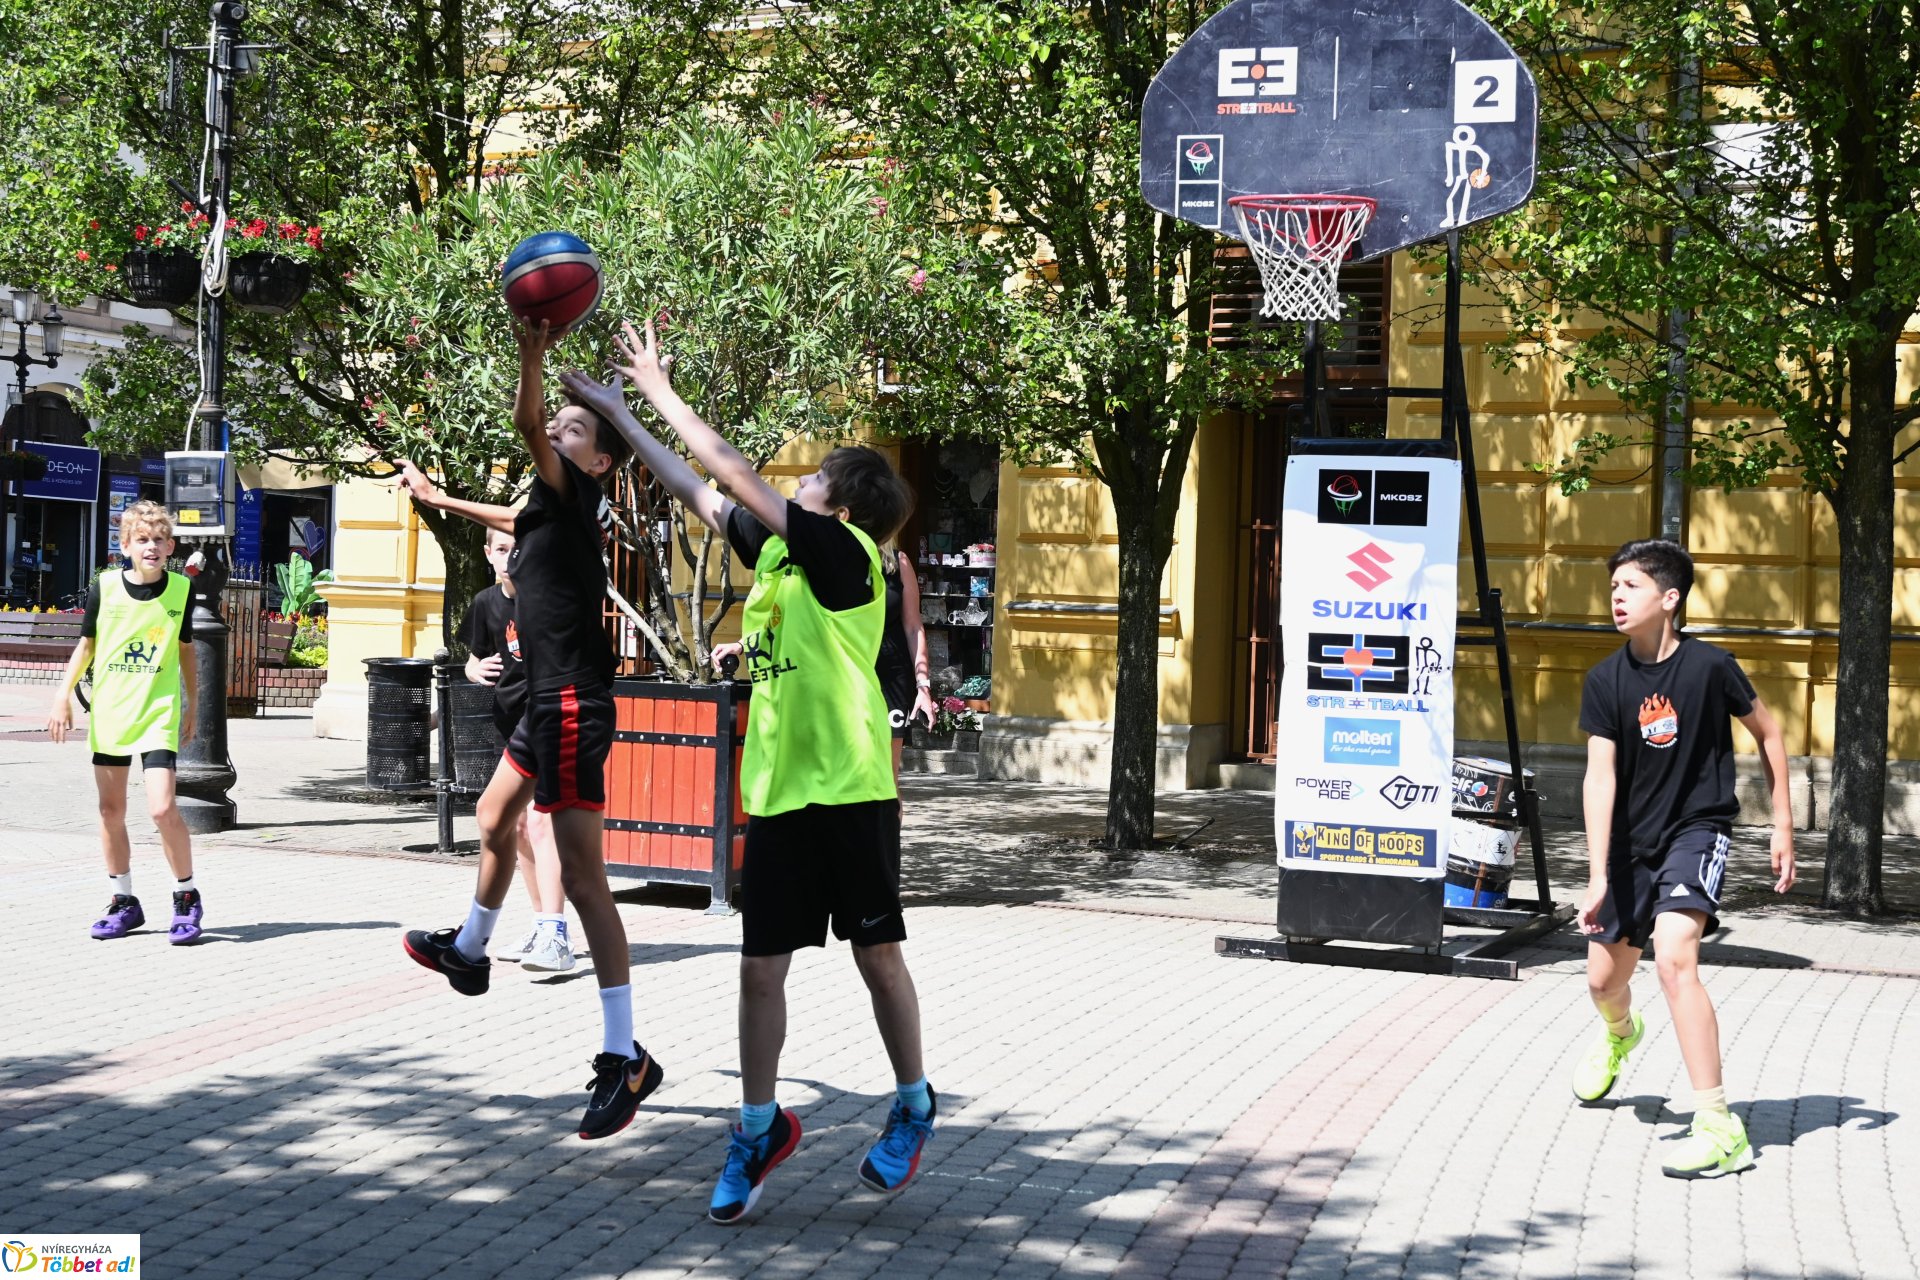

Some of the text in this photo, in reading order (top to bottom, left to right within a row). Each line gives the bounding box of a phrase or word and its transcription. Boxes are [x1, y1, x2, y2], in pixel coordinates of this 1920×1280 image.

[1473, 75, 1500, 107] 2
[1182, 200, 1215, 208] MKOSZ
[47, 460, 84, 475] DEON
[1381, 493, 1423, 502] MKOSZ
[1312, 599, 1427, 621] SUZUKI
[1332, 729, 1393, 746] molten
[1370, 748, 1392, 756] game
[1295, 777, 1352, 790] POWER
[1318, 789, 1351, 800] ADE
[1394, 783, 1439, 803] TOTI
[1317, 826, 1423, 853] KING OF HOOPS
[1319, 853, 1344, 862] SPORTS
[1345, 855, 1367, 864] CARDS
